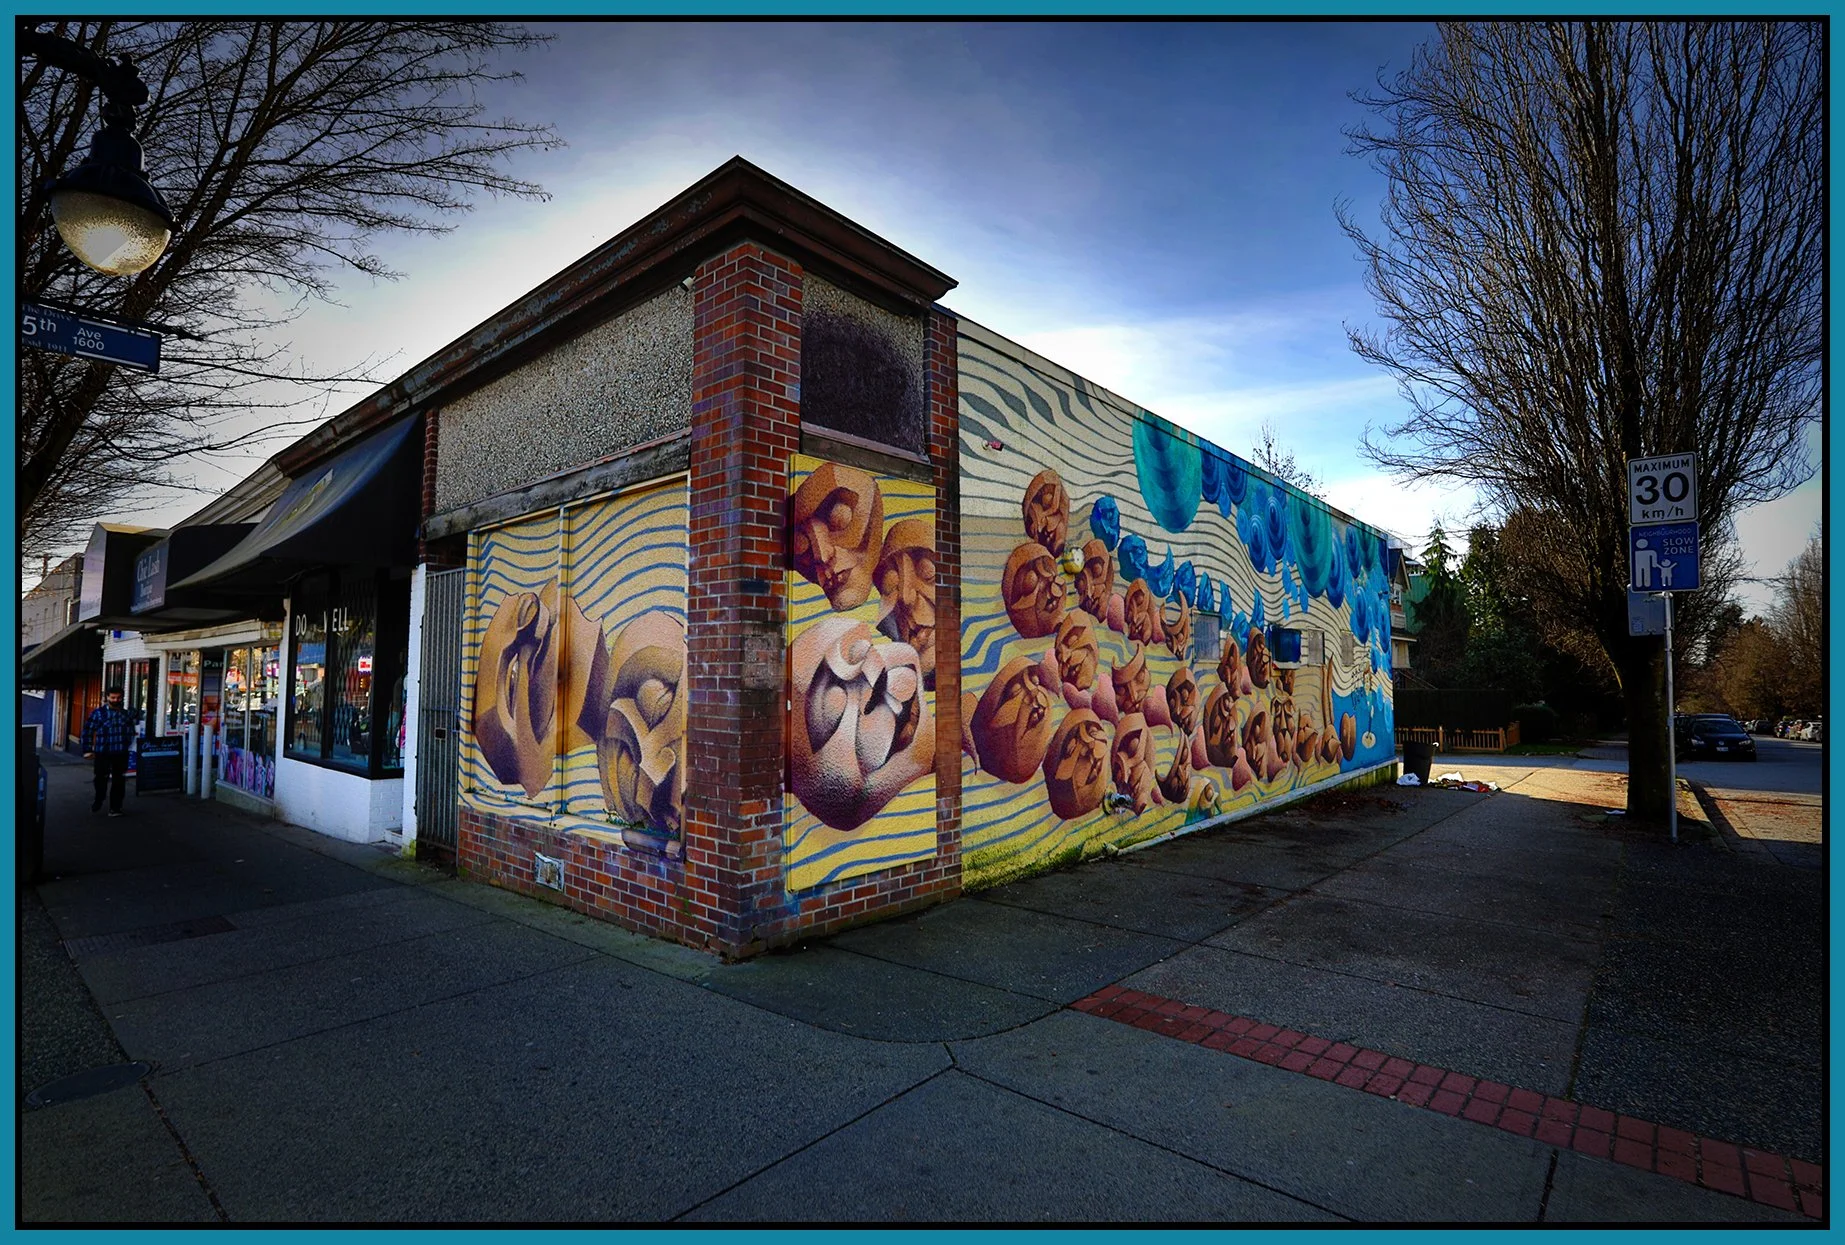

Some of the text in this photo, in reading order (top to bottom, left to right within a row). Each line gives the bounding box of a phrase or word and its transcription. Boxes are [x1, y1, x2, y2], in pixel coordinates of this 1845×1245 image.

[22, 315, 102, 340] 5th Ave
[72, 335, 105, 351] 1600
[1634, 459, 1689, 473] MAXIMUM
[1636, 472, 1689, 505] 30
[1642, 506, 1683, 519] km/h
[1662, 536, 1695, 547] SLOW
[1663, 545, 1695, 555] ZONE
[295, 613, 307, 637] DO
